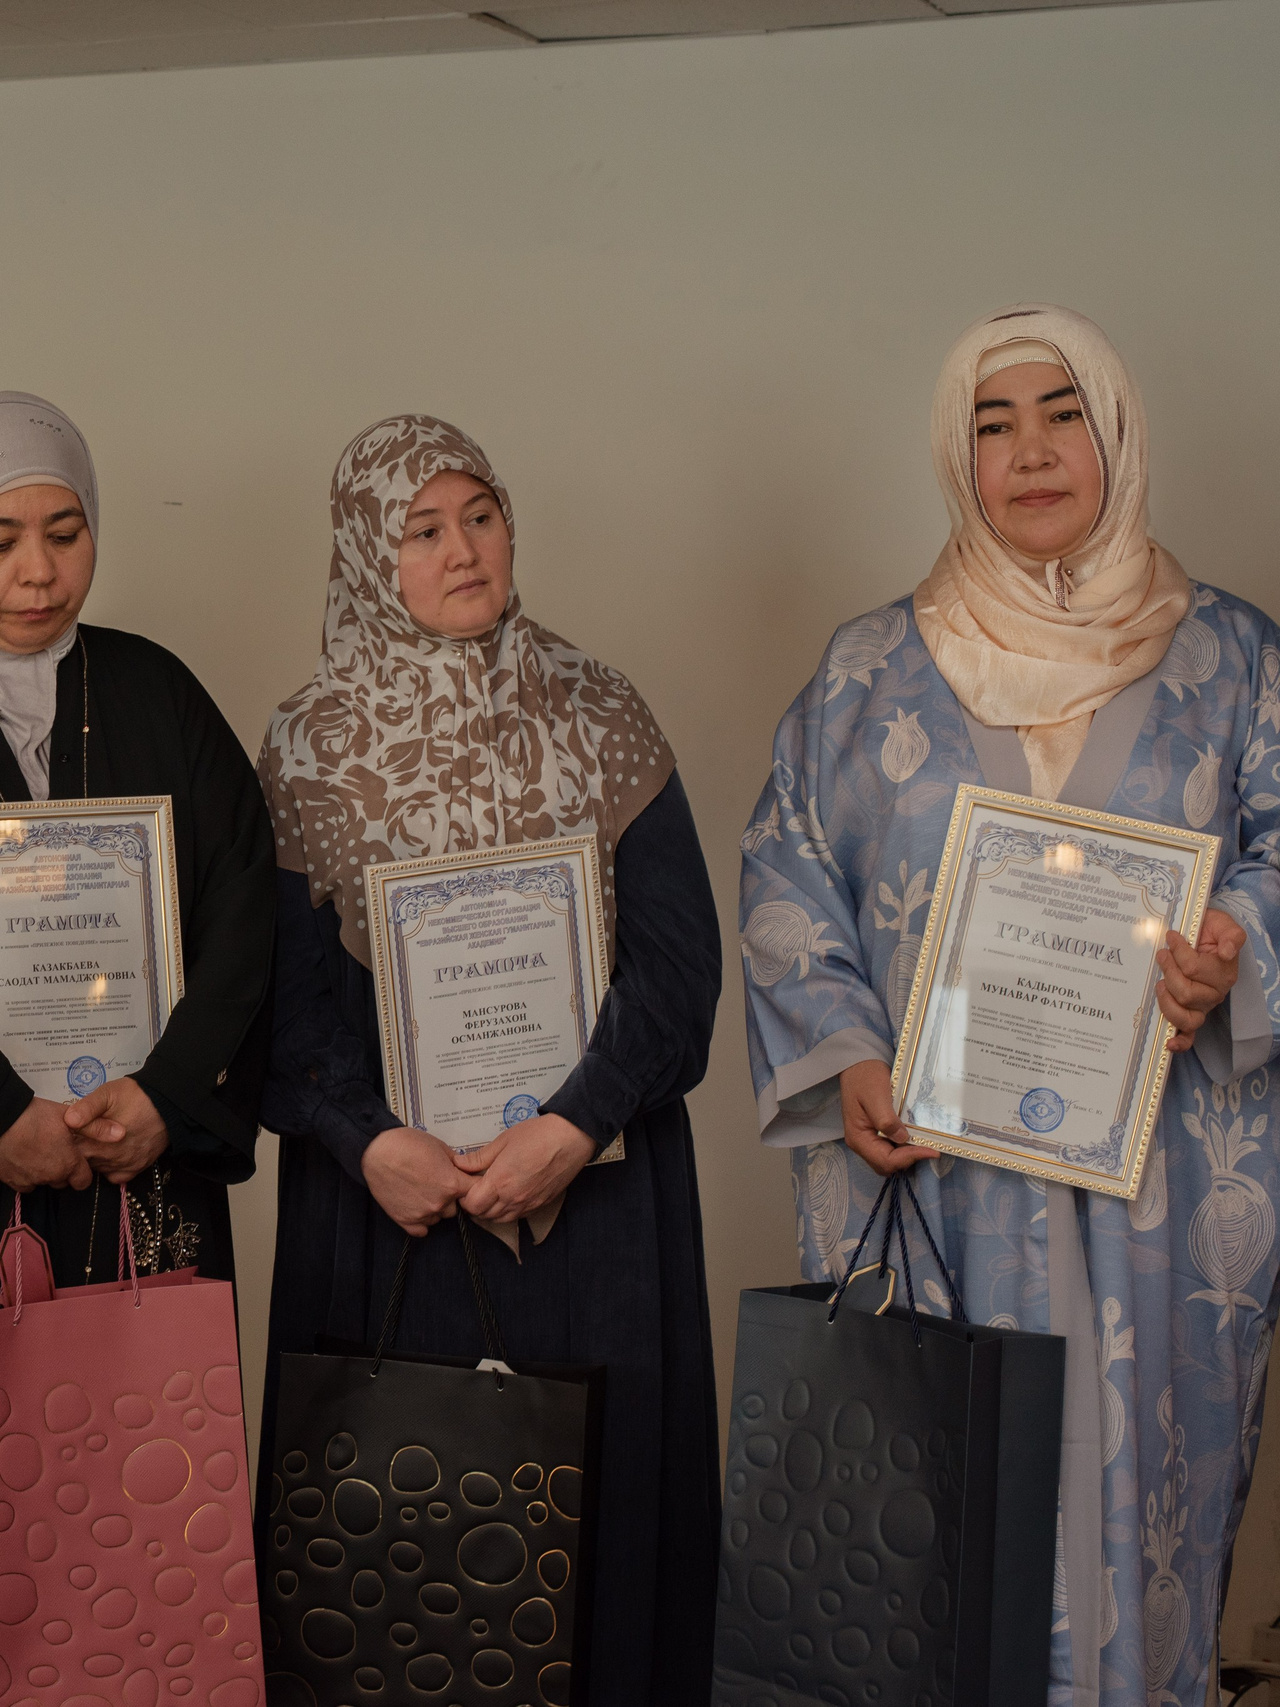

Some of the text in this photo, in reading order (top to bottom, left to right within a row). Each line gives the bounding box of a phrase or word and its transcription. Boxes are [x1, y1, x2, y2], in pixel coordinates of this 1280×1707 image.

[5, 912, 120, 933] ГРАМОТА
[993, 920, 1126, 965] ГРАМОТА
[32, 960, 99, 972] КАЗАКБАЕВА
[433, 951, 547, 983] ГРАМОТА
[43, 970, 135, 985] МАМАДЖОНОВНА
[1016, 977, 1082, 1001] КАДЫРОВА
[462, 1000, 526, 1018] МАНСУРОВА
[980, 982, 1113, 1021] МУНАВАР ФАТТОЕВНА
[464, 1013, 526, 1030] ФЕРУЗАХОН
[451, 1022, 542, 1044] ОСМАНЖАНОВНА
